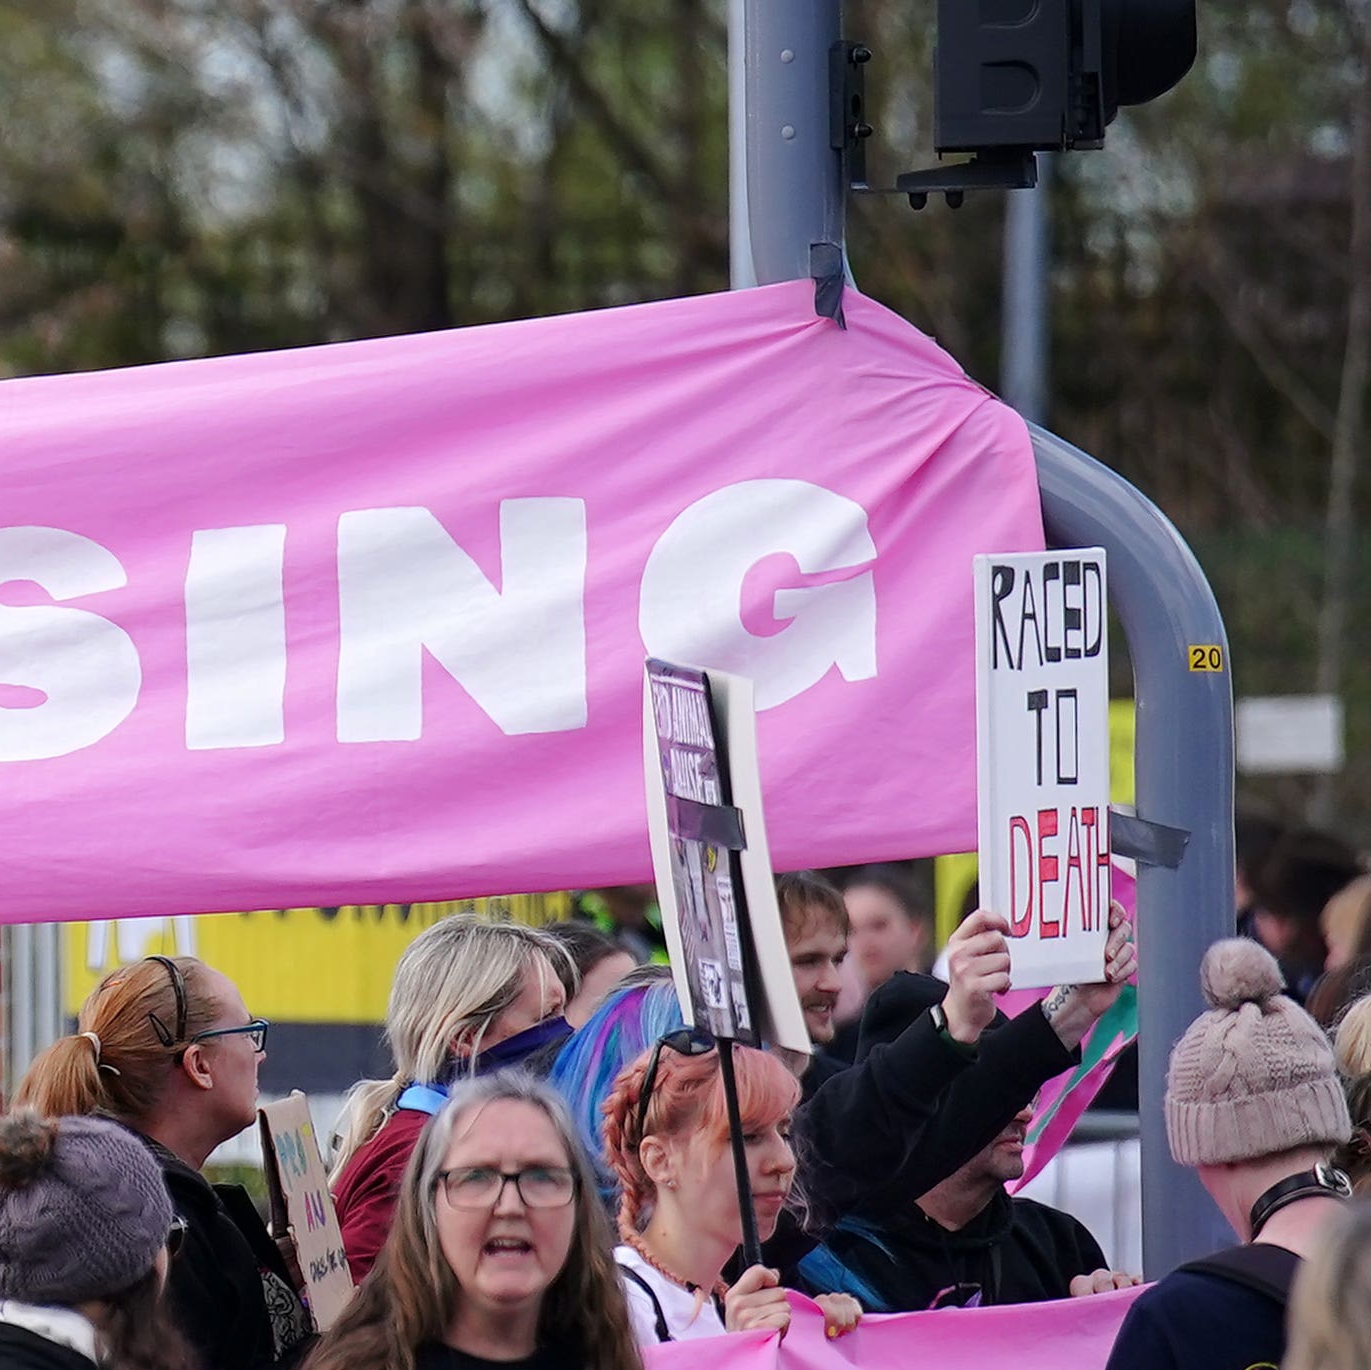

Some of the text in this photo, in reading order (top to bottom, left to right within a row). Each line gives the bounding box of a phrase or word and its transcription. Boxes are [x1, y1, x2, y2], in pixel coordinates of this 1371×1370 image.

[991, 560, 1102, 670] RACED
[1192, 647, 1222, 670] 20
[1027, 689, 1078, 786] TO
[1009, 805, 1111, 940] DEATH
